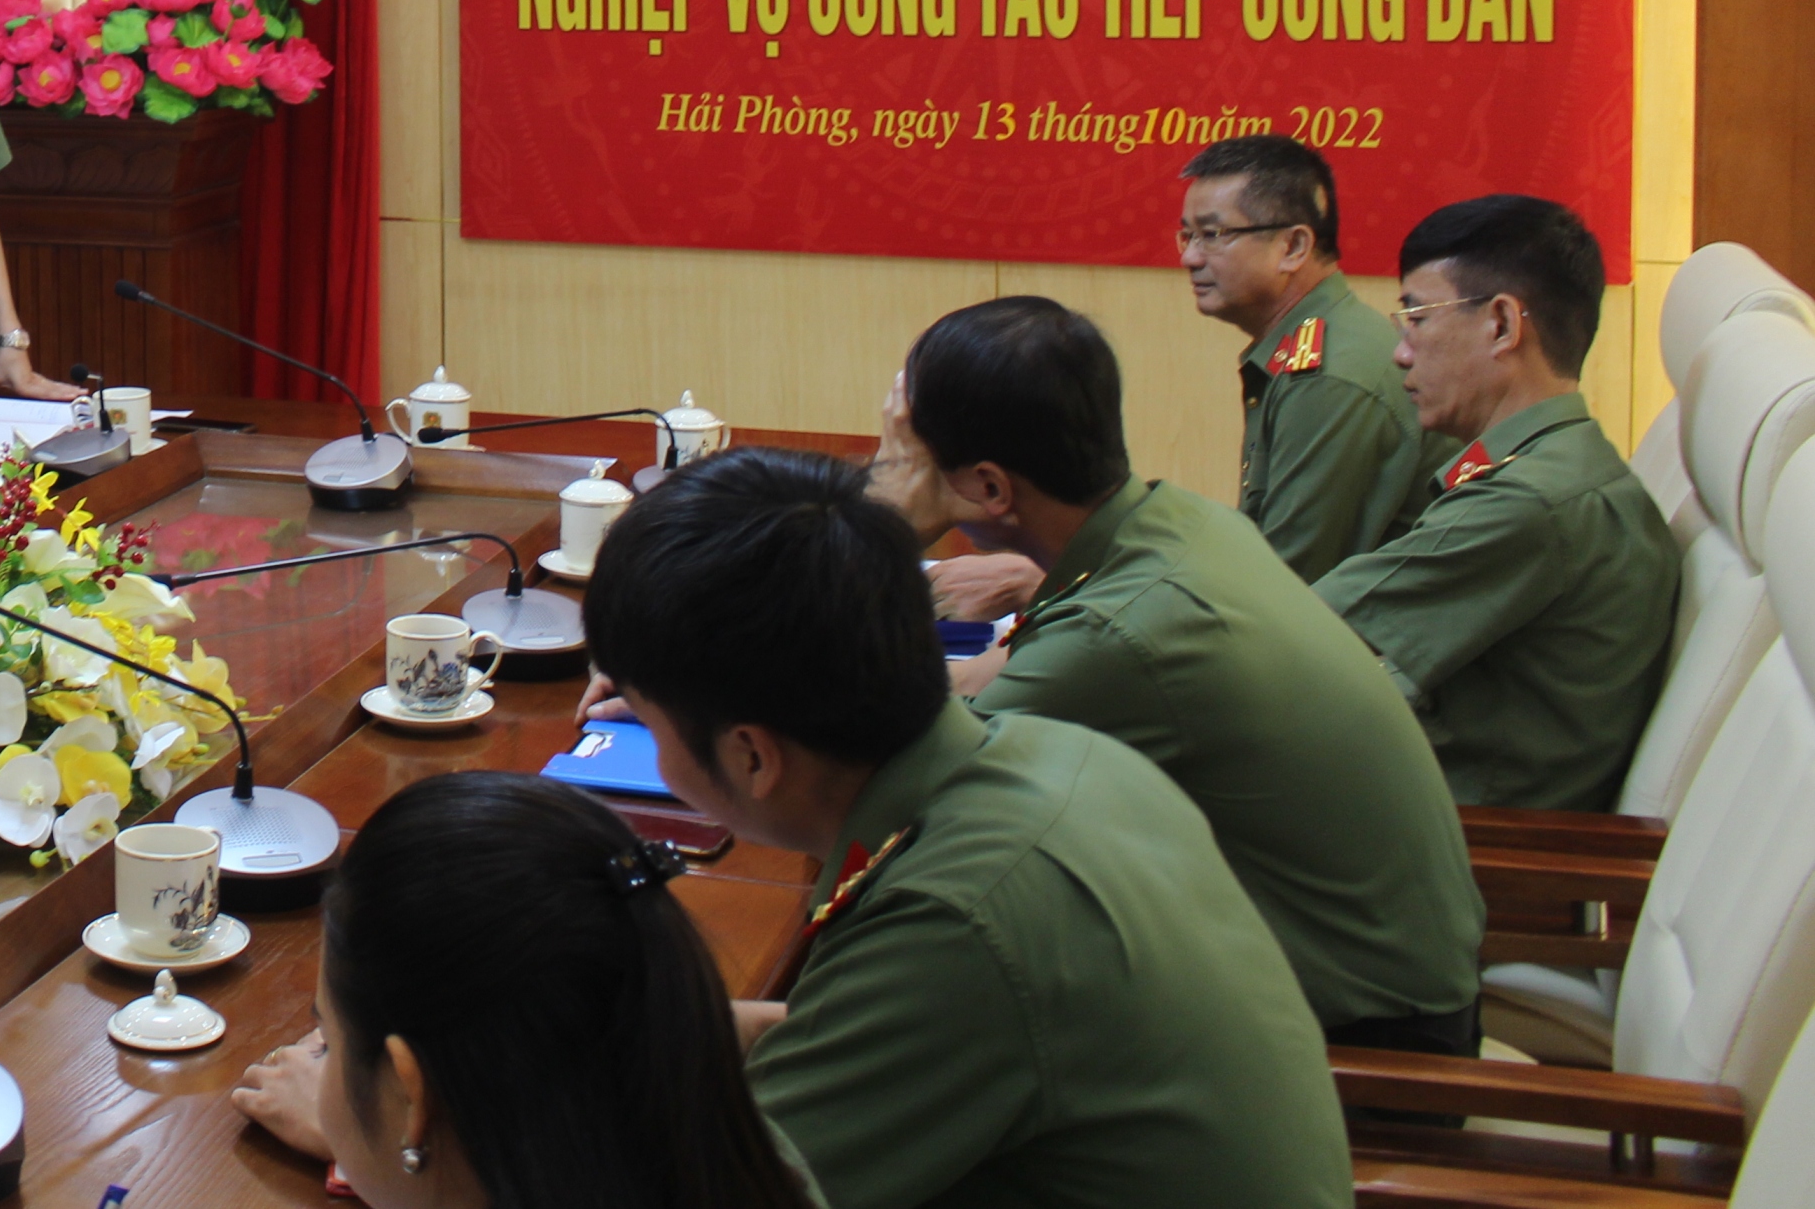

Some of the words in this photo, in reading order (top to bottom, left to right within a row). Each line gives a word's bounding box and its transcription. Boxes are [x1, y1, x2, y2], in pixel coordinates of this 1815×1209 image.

[656, 92, 725, 133] Hải
[733, 95, 859, 146] Phòng,
[872, 99, 960, 149] ngày
[972, 100, 1016, 141] 13
[1289, 105, 1384, 148] 2022
